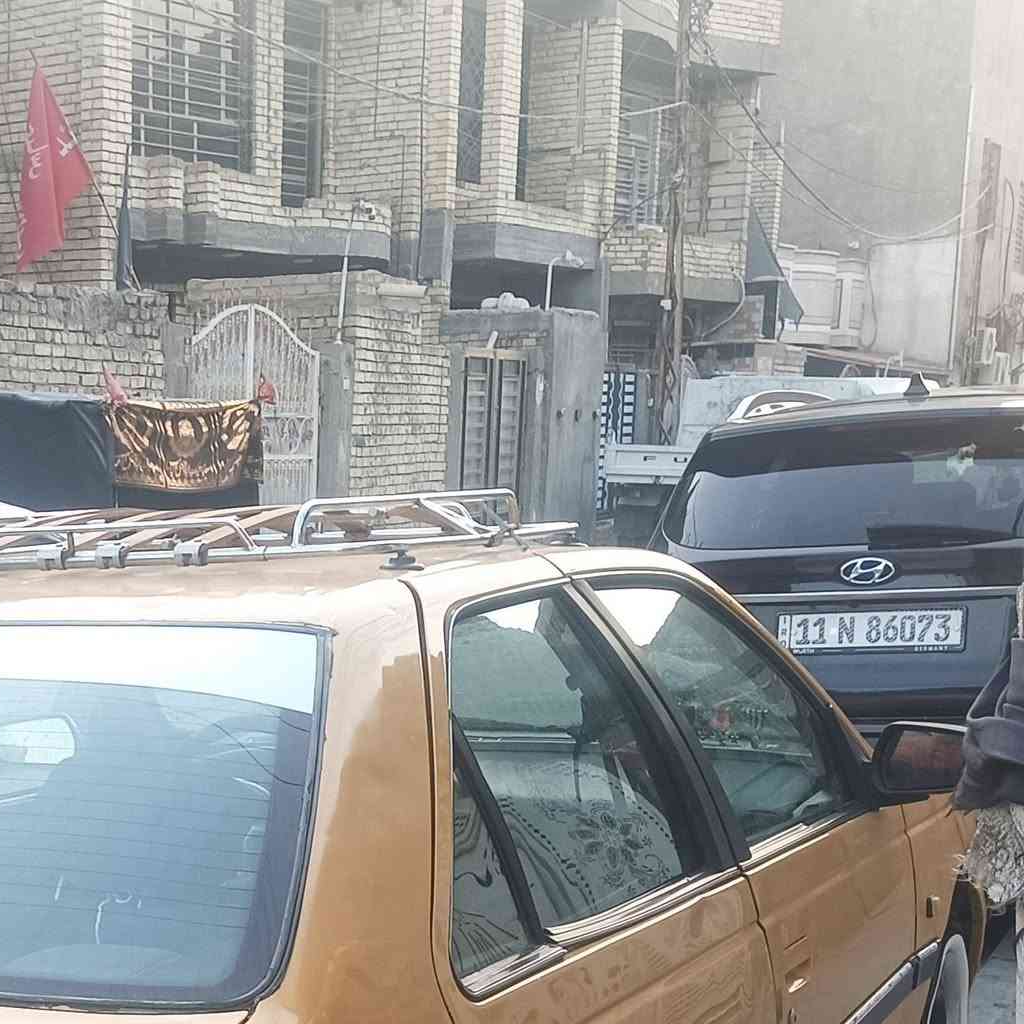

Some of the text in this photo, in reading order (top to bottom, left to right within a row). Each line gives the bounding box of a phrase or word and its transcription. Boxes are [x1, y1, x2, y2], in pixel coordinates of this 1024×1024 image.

[796, 614, 952, 645] 11 N 86073
